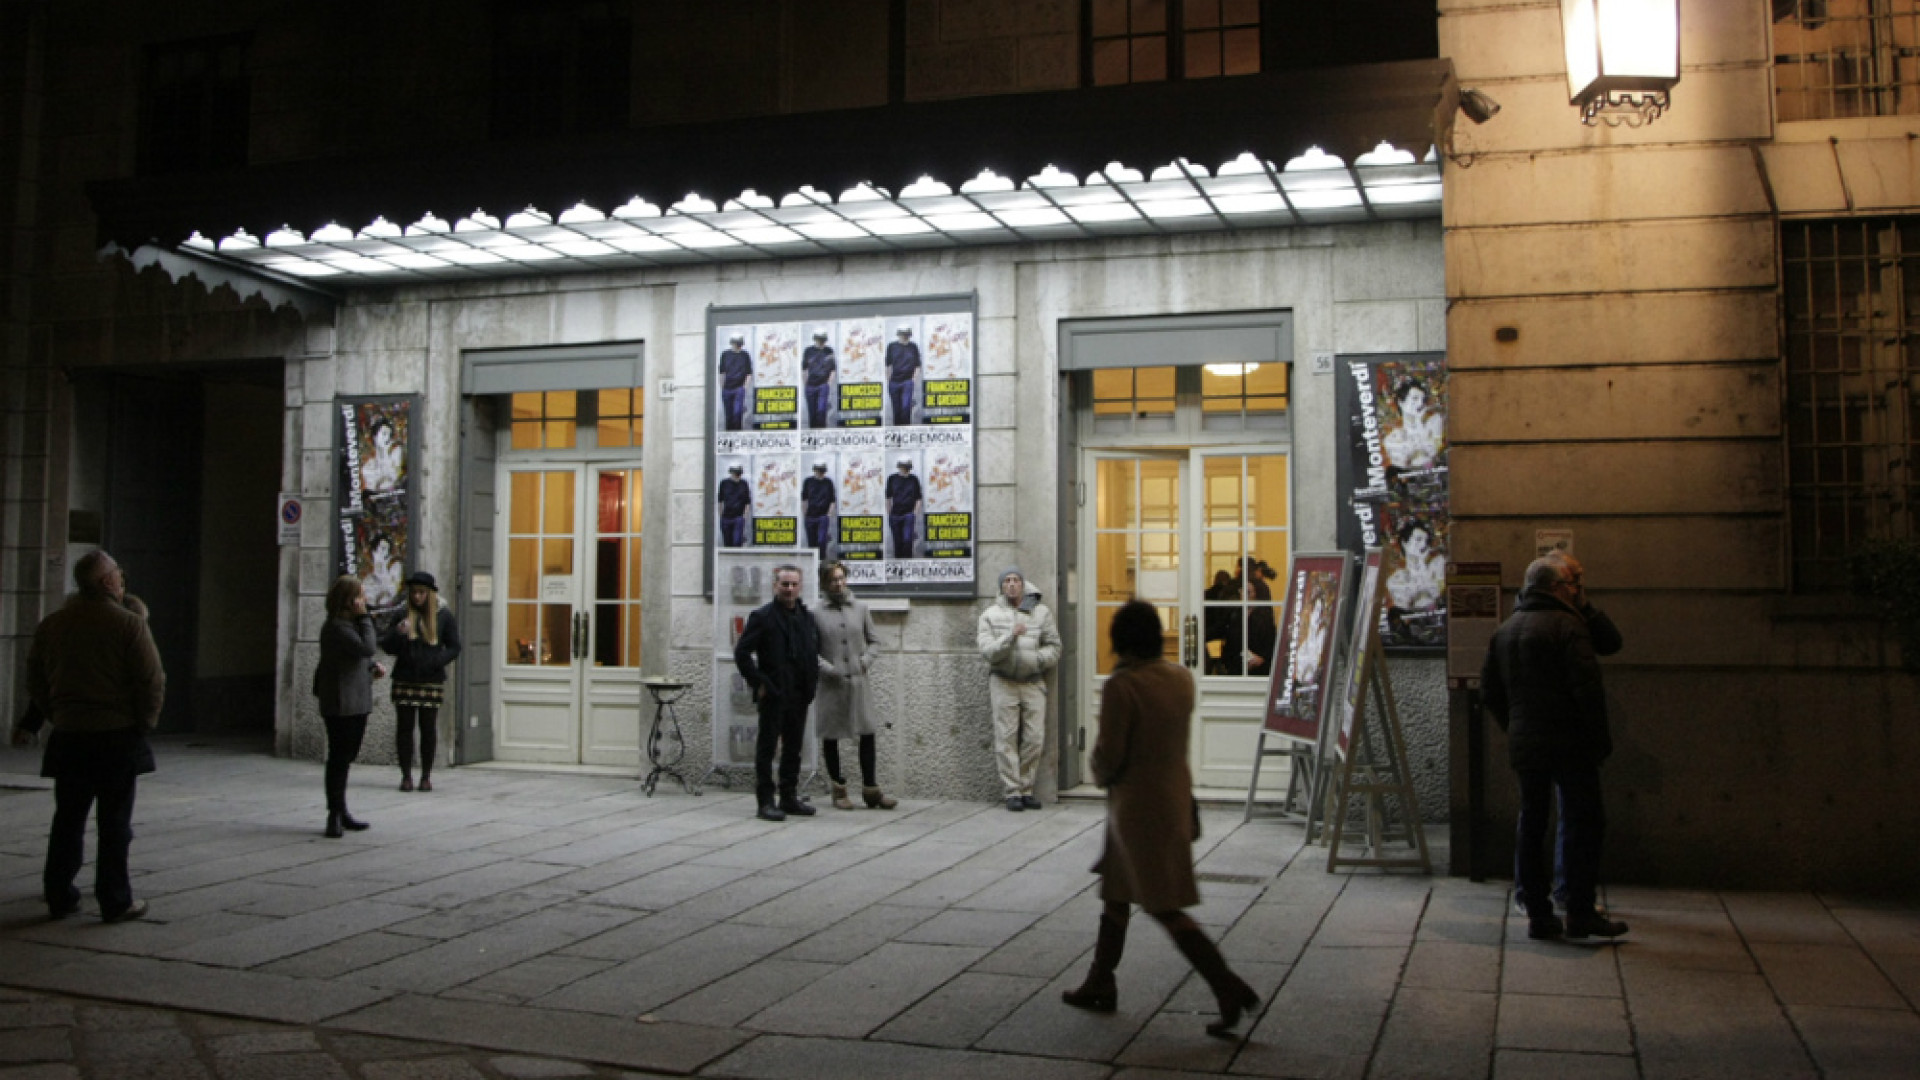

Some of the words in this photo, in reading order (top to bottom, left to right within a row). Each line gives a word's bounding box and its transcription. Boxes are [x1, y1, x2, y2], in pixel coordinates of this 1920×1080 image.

[733, 438, 791, 449] CREMONA
[818, 435, 877, 448] CREMONA
[902, 432, 963, 445] CREMONA
[903, 566, 965, 579] CREMONA
